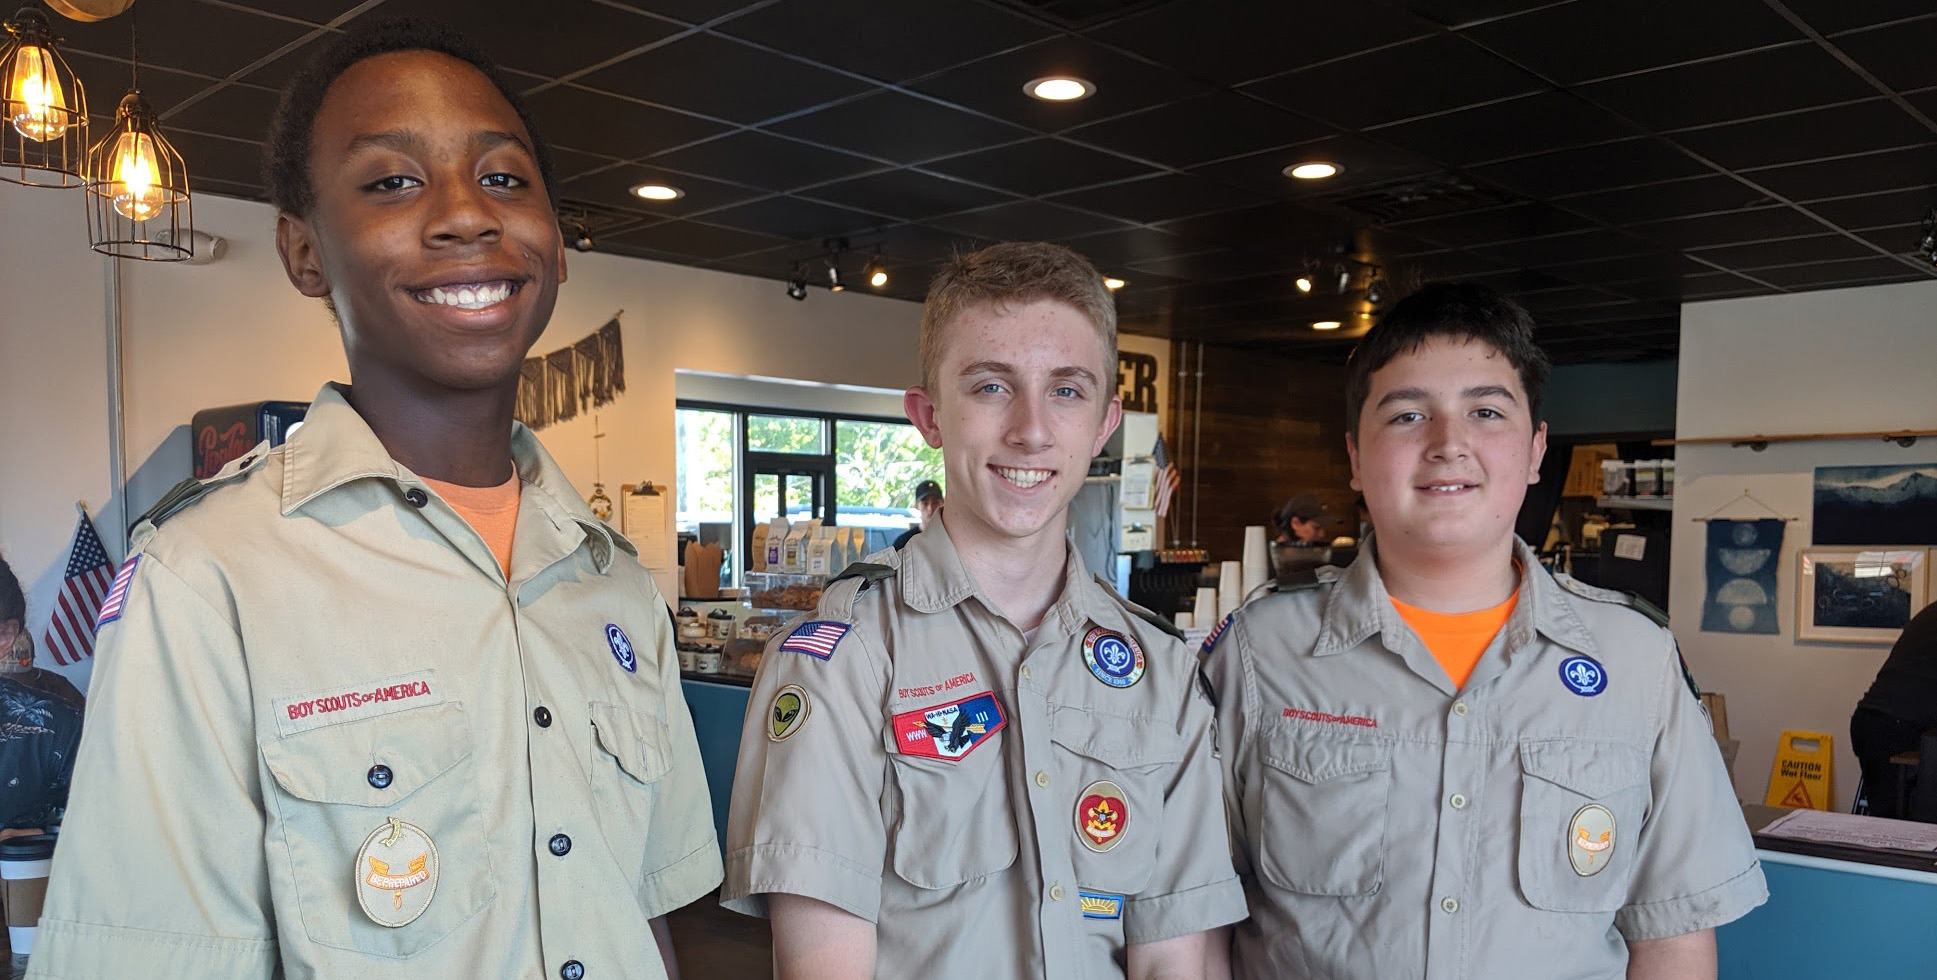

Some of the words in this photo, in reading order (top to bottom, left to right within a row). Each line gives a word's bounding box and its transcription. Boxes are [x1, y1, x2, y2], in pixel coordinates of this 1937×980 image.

[898, 688, 910, 699] BOY
[910, 686, 935, 698] SCOUTS
[944, 672, 977, 691] AMERICA
[287, 700, 314, 720] BOY
[316, 692, 361, 714] SCOUTS
[374, 681, 431, 703] AMERICA
[1282, 708, 1300, 718] BOY
[1299, 710, 1333, 723] SCOUTS
[1339, 714, 1377, 728] AMERICA
[906, 729, 927, 742] WWW
[1782, 760, 1821, 771] CAUTION
[1781, 769, 1797, 777] Wet
[1800, 771, 1821, 780] Floor
